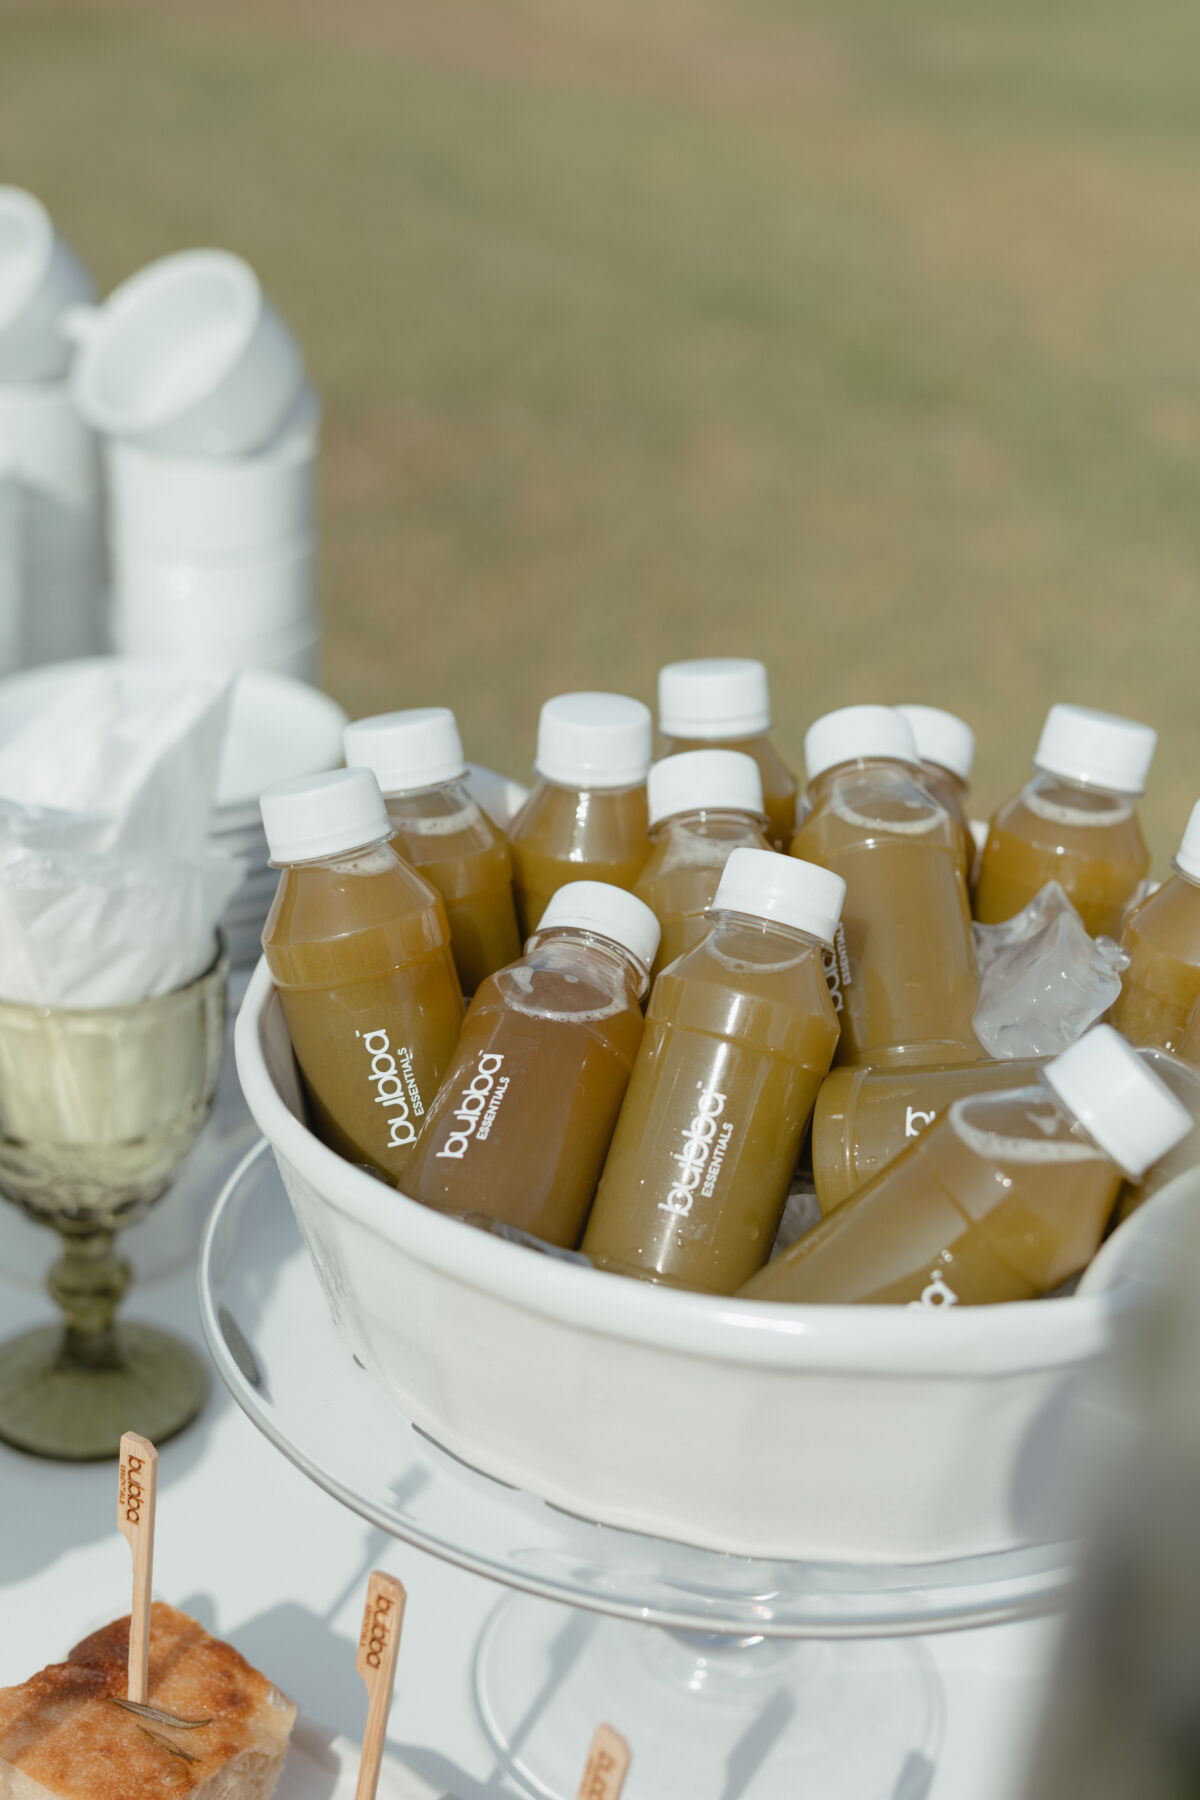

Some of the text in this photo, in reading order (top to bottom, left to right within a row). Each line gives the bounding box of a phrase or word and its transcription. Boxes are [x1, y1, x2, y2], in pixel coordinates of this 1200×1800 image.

[362, 1028, 418, 1148] bubba
[397, 1047, 425, 1117] ESSENTIALS
[435, 1053, 505, 1159] bubba
[476, 1076, 510, 1141] ESSENTIALS
[657, 1089, 727, 1217] bubba
[701, 1122, 734, 1198] ESSENTIALS
[126, 1454, 145, 1526] bubba
[366, 1594, 395, 1670] bubba
